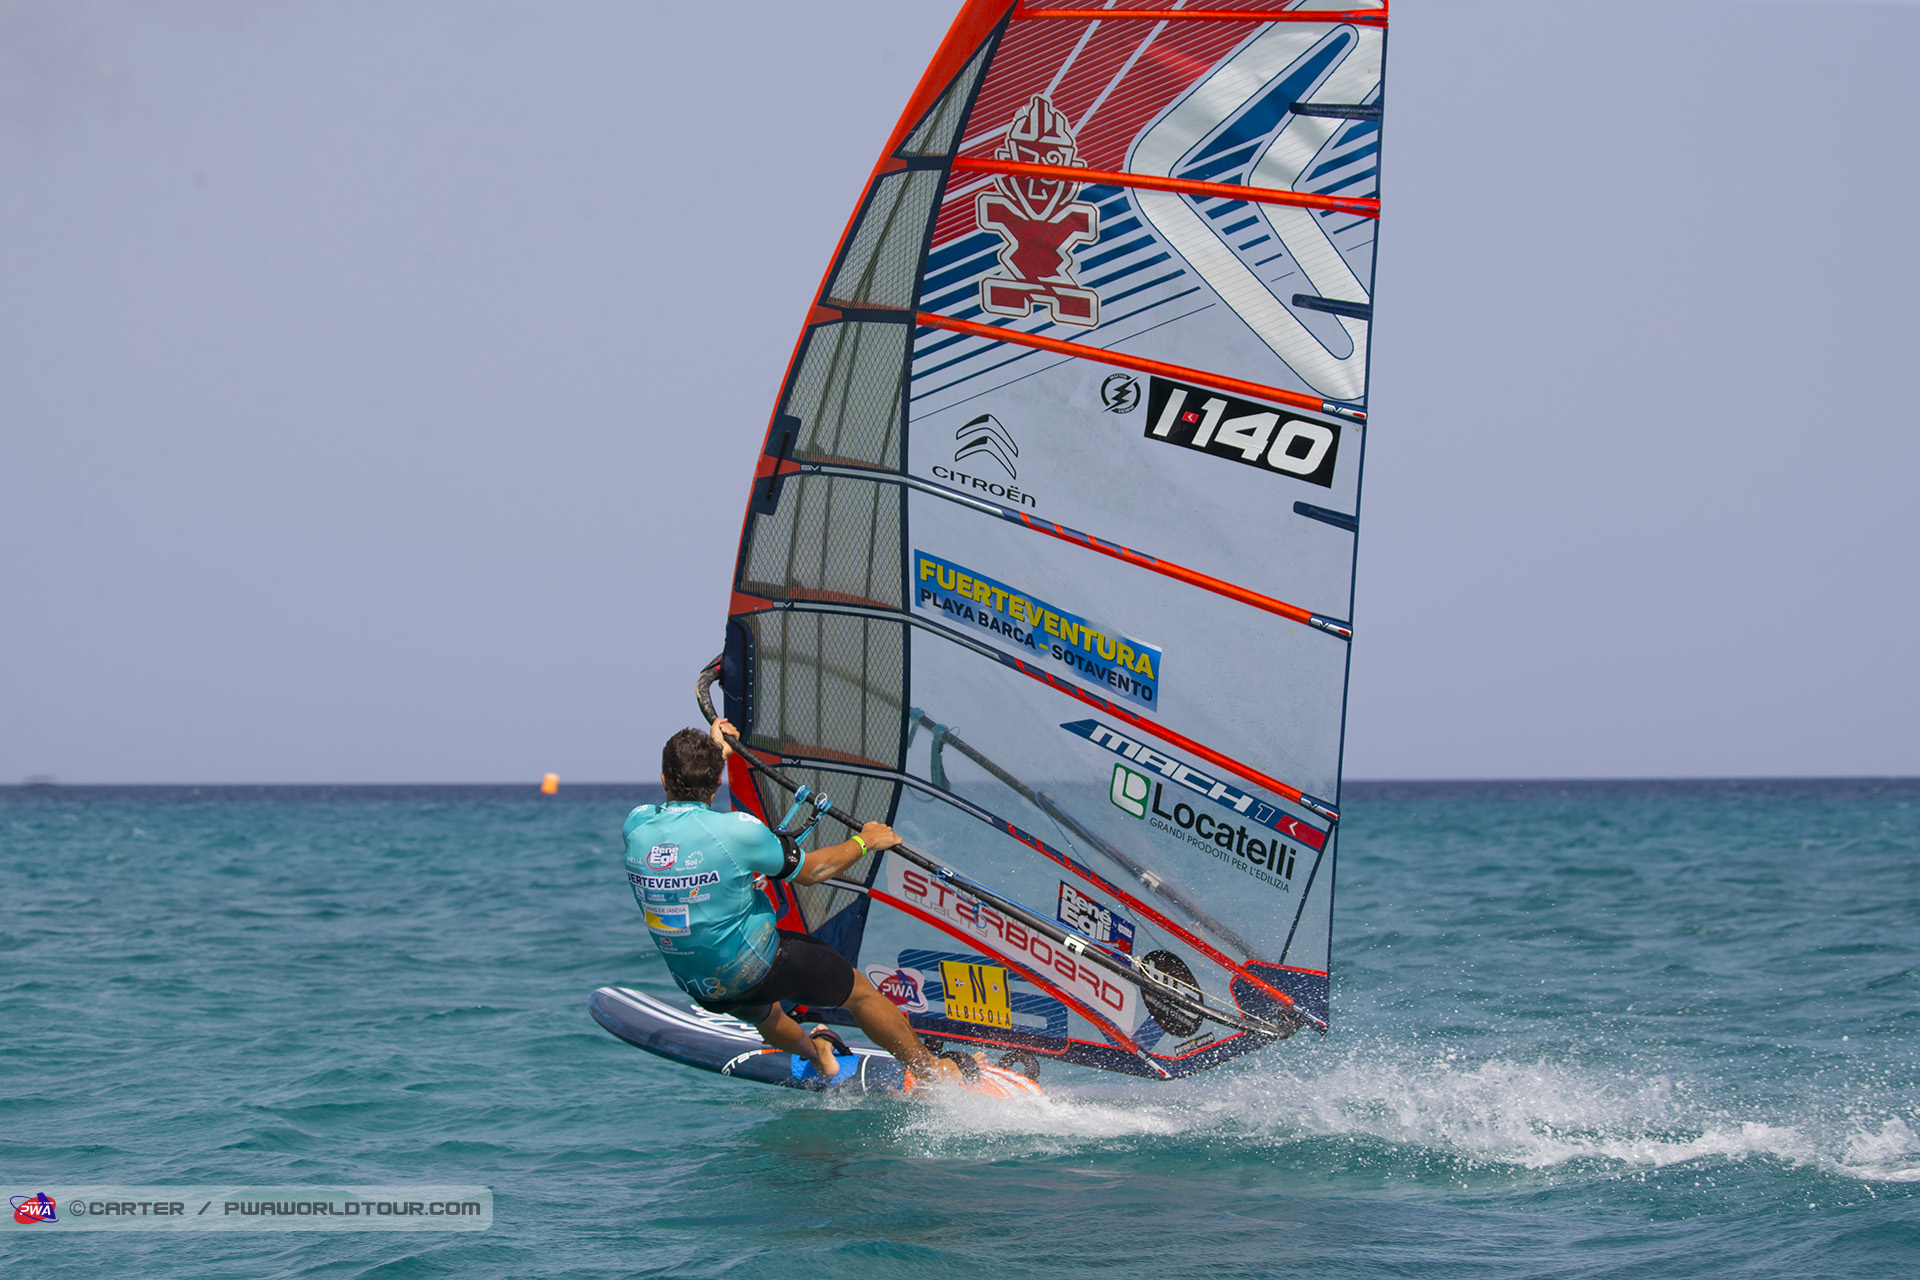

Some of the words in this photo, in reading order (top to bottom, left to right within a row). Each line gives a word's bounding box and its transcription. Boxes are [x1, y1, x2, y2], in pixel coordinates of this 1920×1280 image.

[920, 558, 1155, 680] FUERTEVENTURA
[920, 588, 975, 622] PLAYA
[978, 611, 1036, 649] BARCA
[1052, 644, 1153, 702] SOTAVENTO
[1150, 818, 1186, 841] GRANDI
[1187, 835, 1230, 864] PRODOTTI
[1232, 858, 1248, 873] PER
[1152, 782, 1297, 880] Locatelli
[1060, 898, 1111, 941] Egli
[1061, 883, 1112, 927] René
[882, 982, 915, 999] PWA
[947, 1003, 1010, 1026] ALBISOLA
